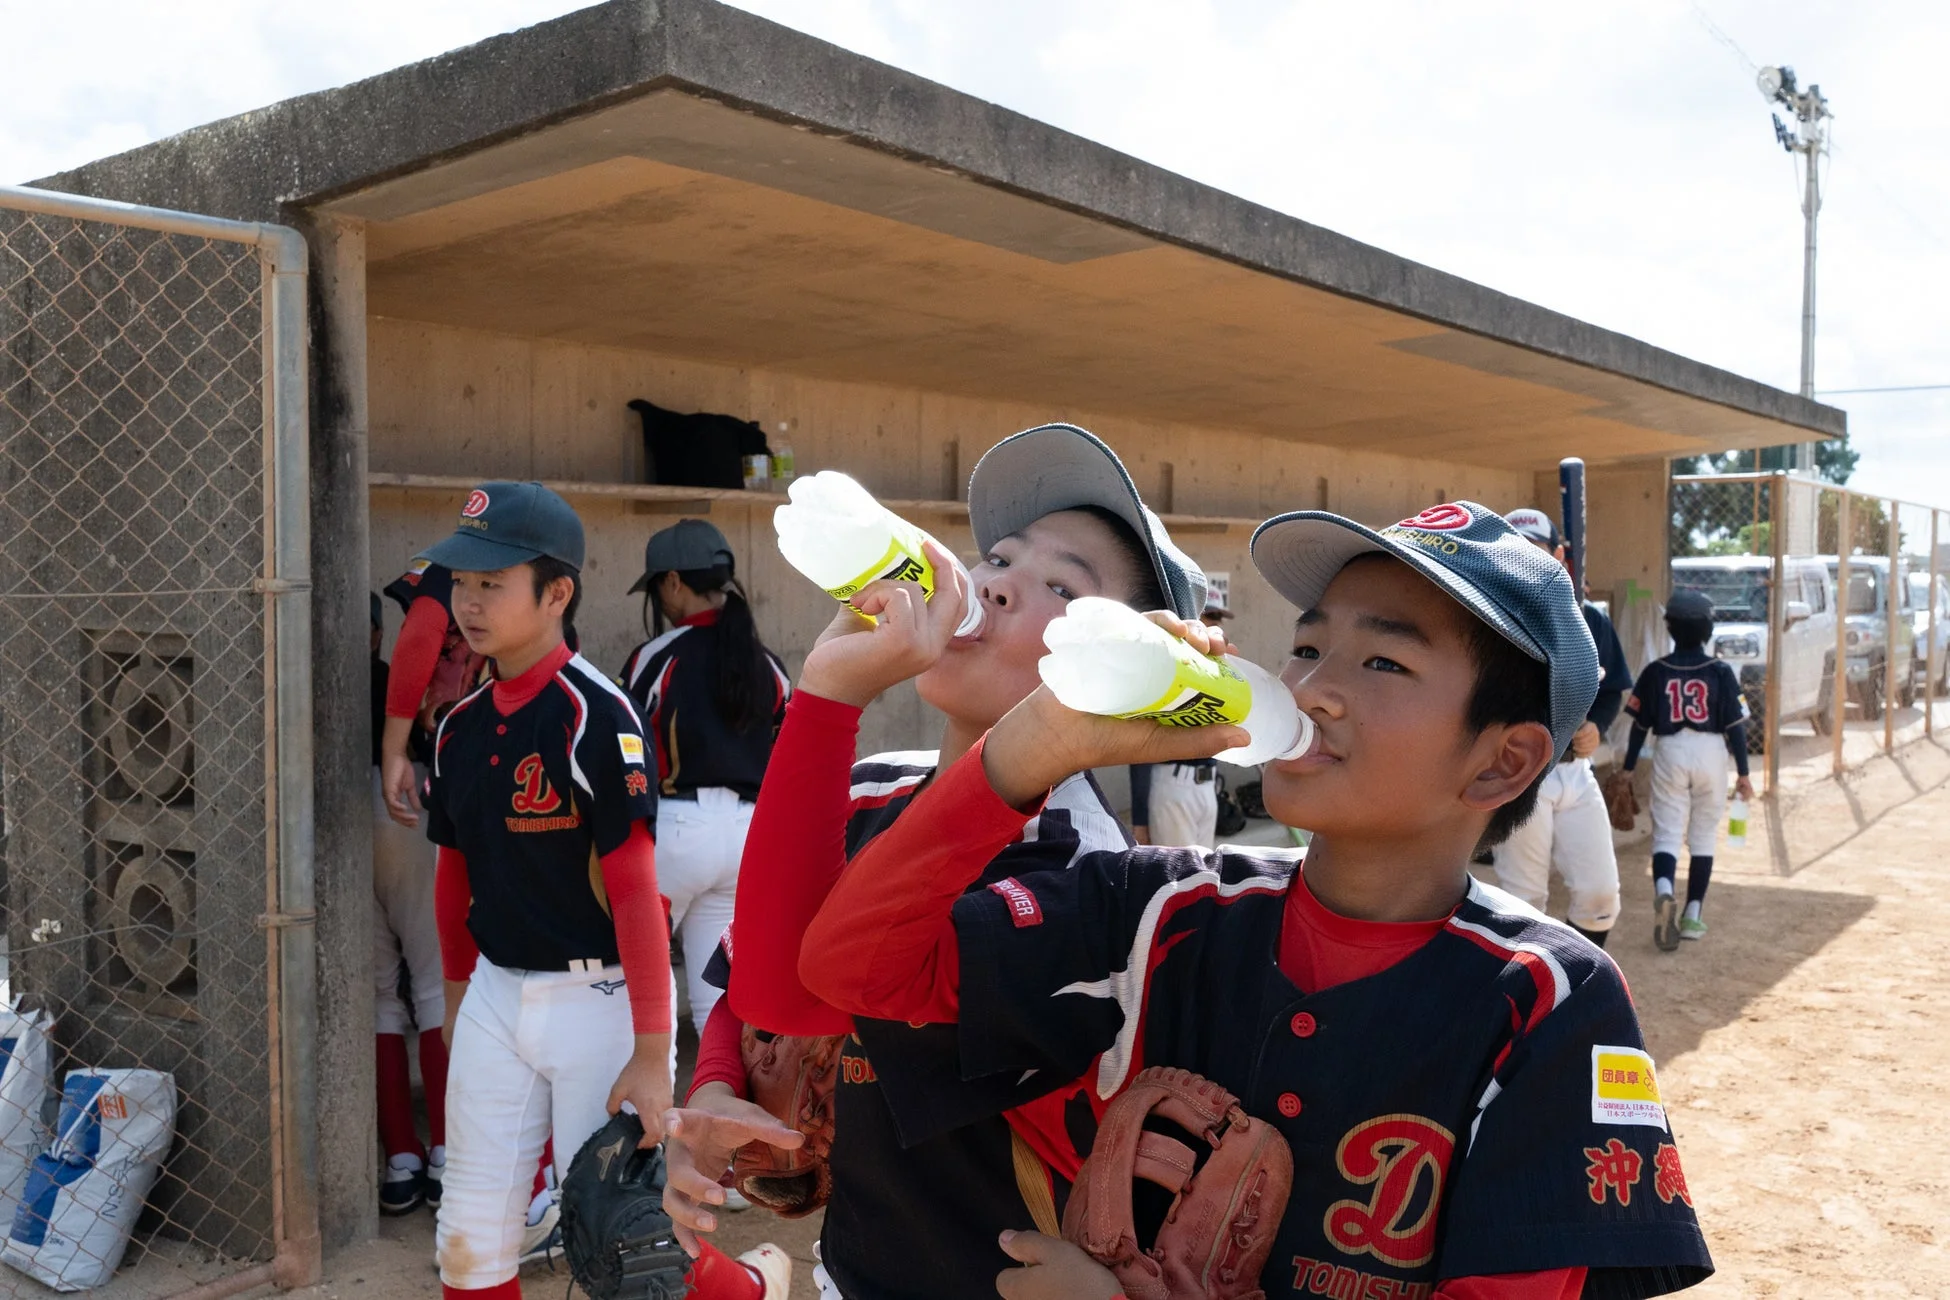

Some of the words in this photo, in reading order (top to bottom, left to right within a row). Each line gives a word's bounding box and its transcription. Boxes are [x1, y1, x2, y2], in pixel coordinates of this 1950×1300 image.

[1665, 679, 1709, 724] 13
[505, 816, 580, 833] TOMISHIRO
[1602, 1068, 1640, 1085] 団員章
[1323, 1113, 1456, 1268] D
[1583, 1138, 1694, 1208] 沖縄
[1292, 1255, 1434, 1300] TOMISHI
